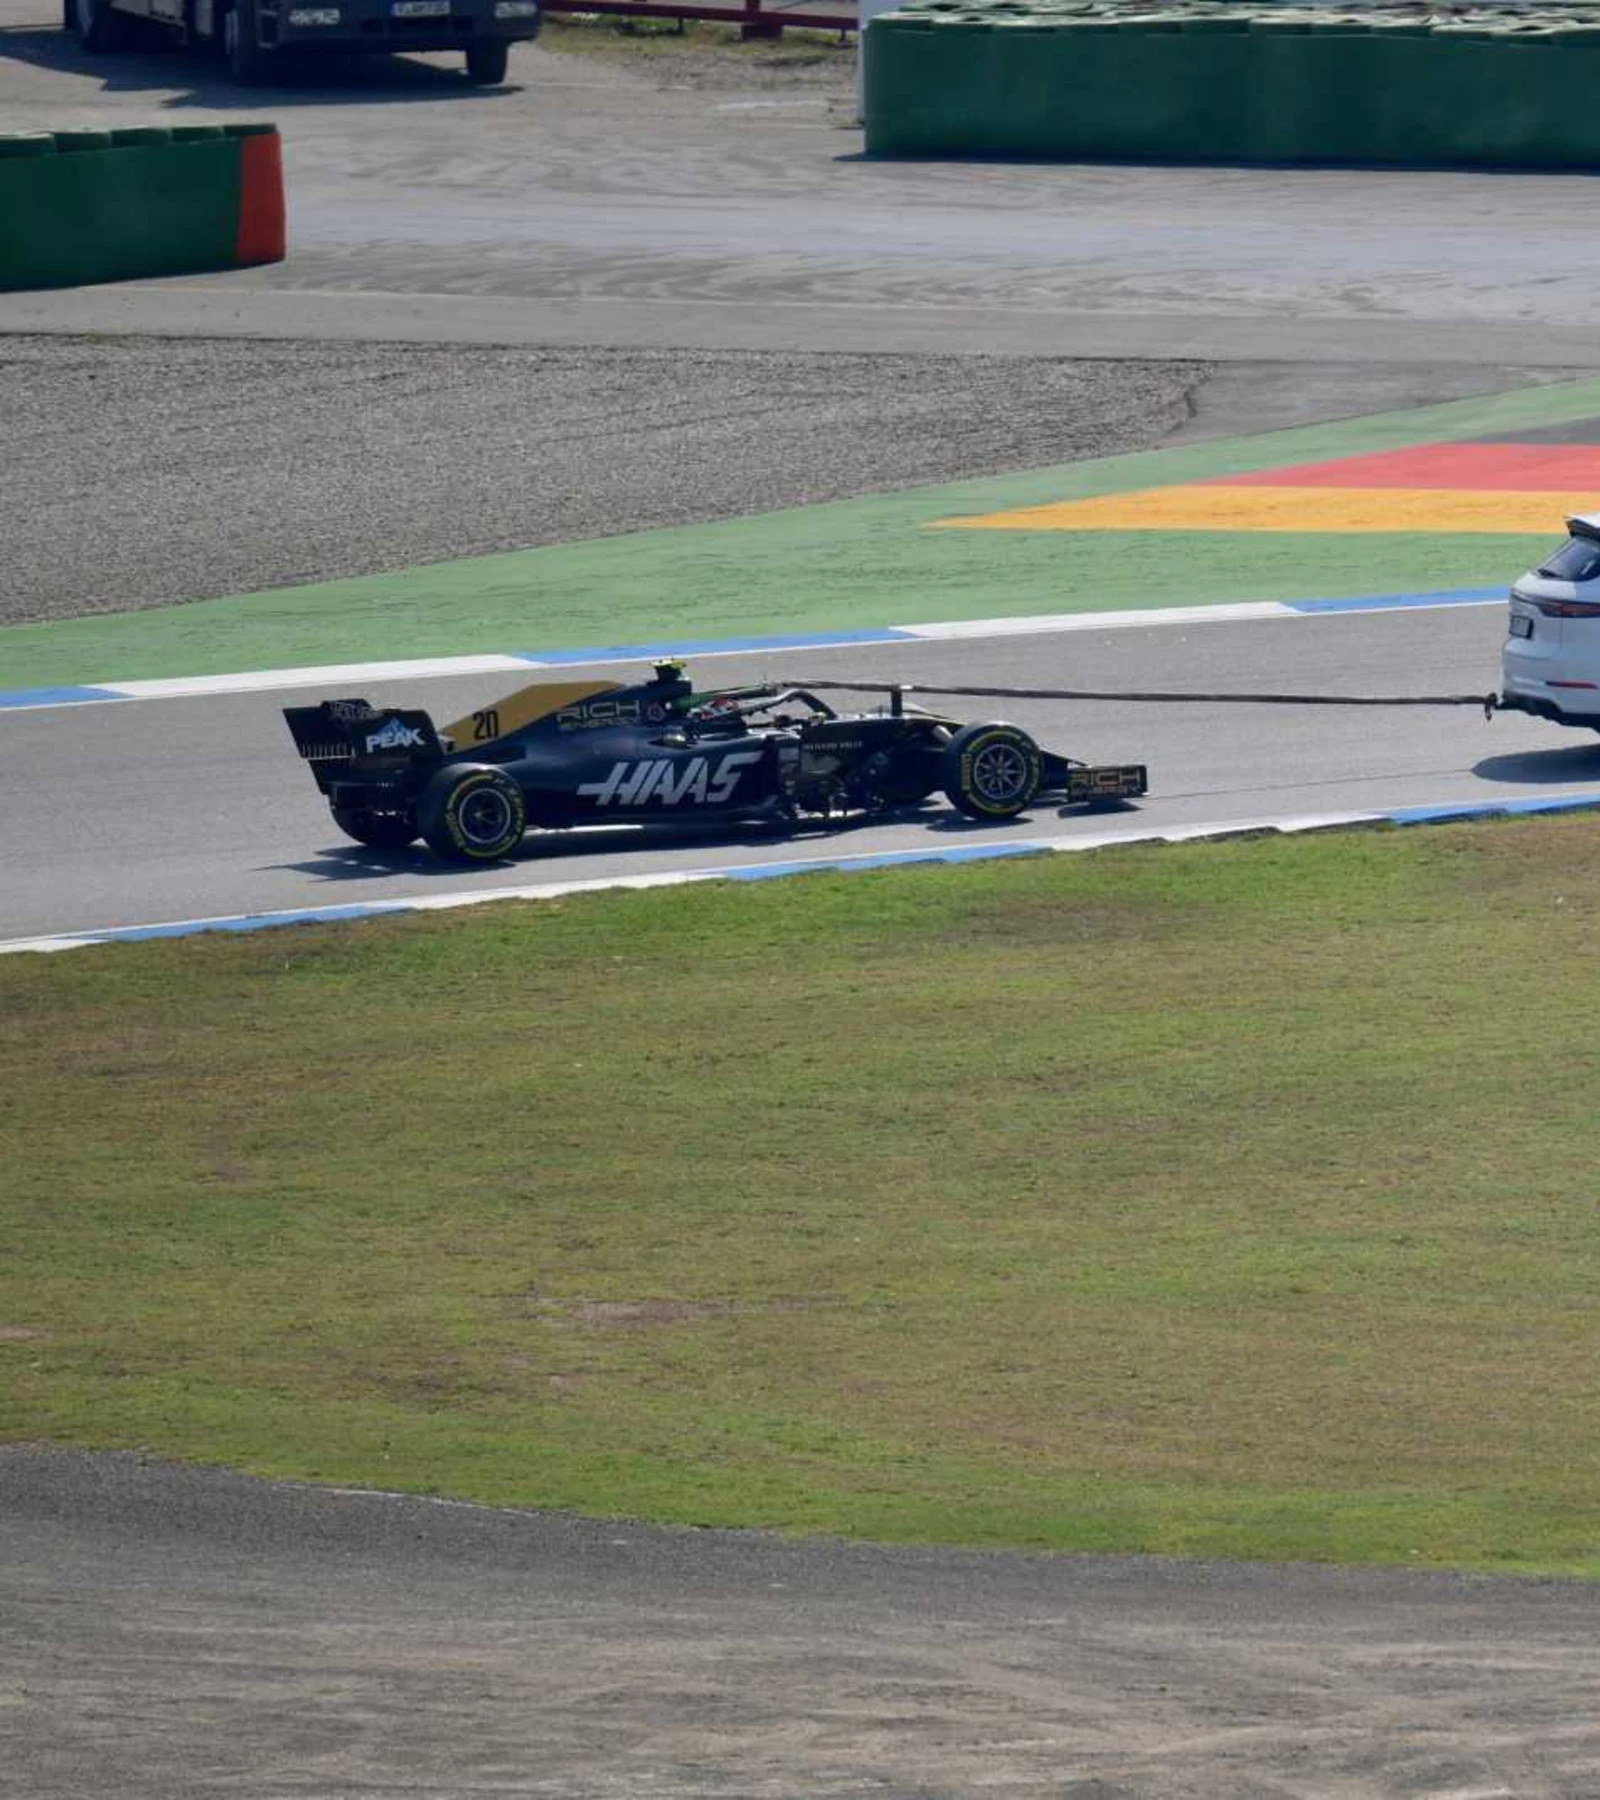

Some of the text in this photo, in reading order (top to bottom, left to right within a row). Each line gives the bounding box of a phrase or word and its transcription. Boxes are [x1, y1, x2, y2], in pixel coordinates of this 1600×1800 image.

[474, 710, 498, 740] 20
[557, 700, 640, 723] RICH
[366, 729, 425, 753] PEAK
[576, 751, 761, 805] HAAS
